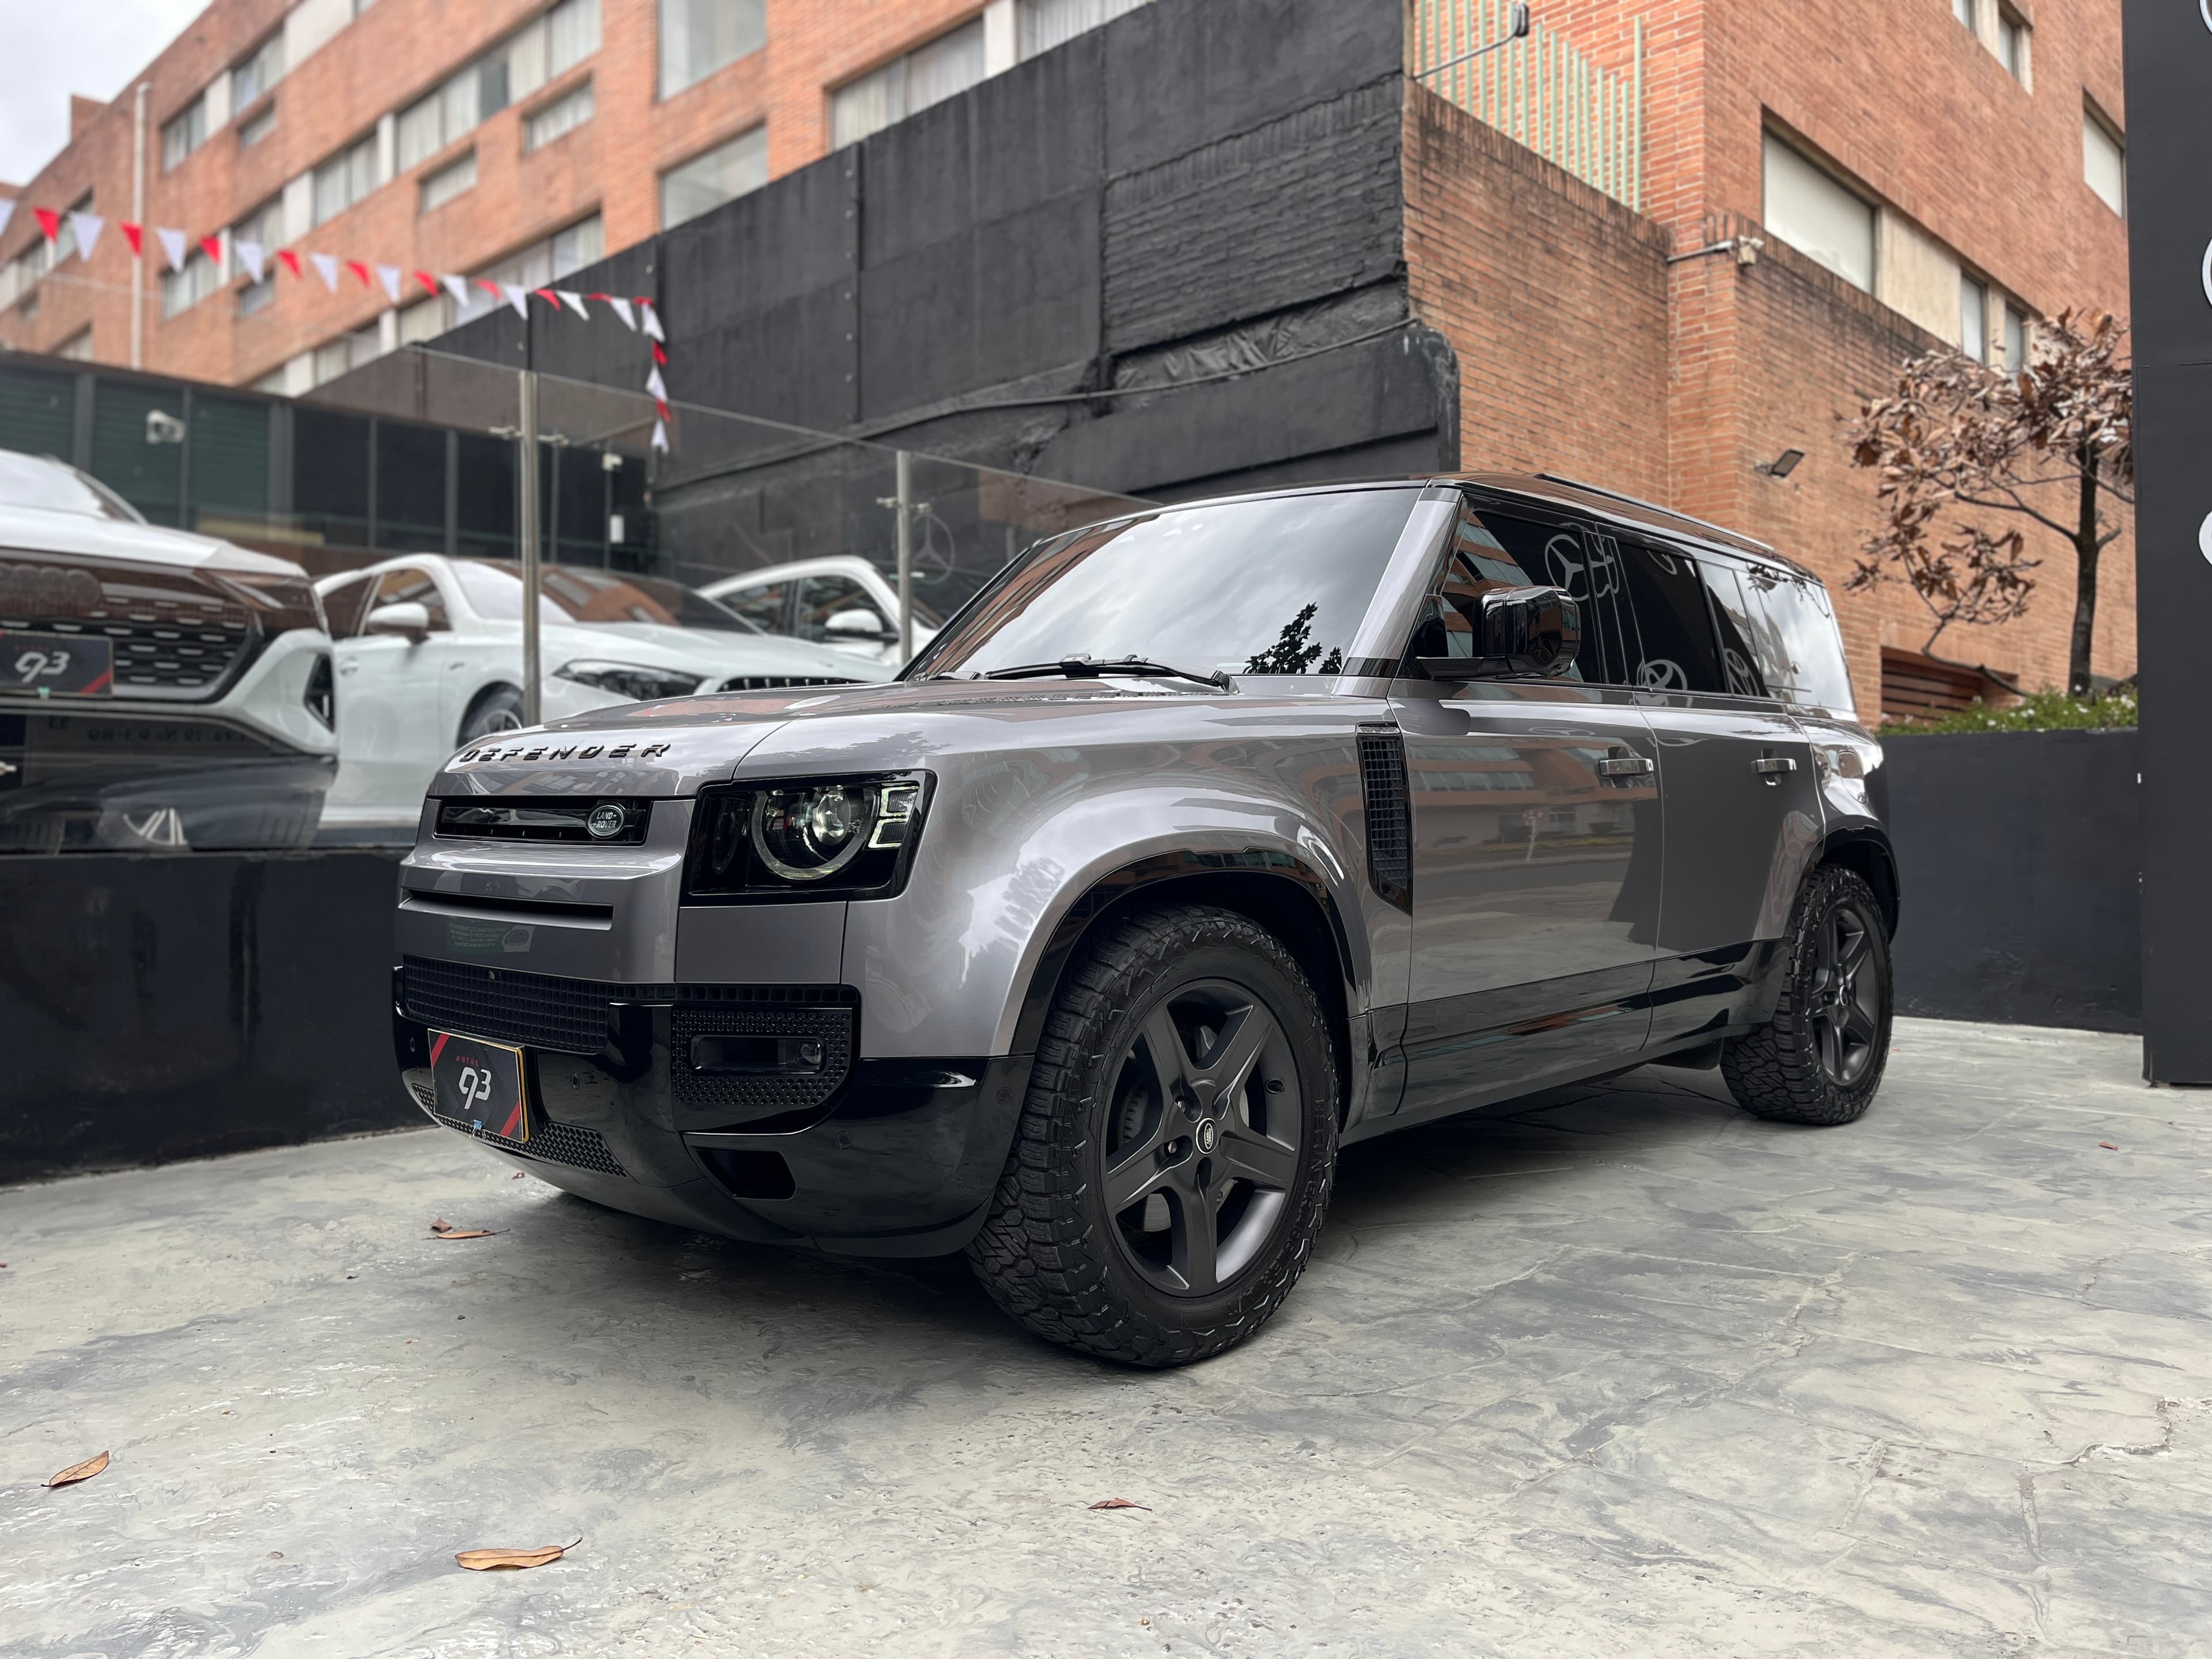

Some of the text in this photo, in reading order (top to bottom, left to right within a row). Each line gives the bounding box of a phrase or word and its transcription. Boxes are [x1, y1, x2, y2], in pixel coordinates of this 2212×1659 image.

[14, 651, 71, 684] 93
[459, 743, 671, 762] DEFENDER
[456, 1055, 479, 1066] AUTOS
[459, 1066, 492, 1110] 93
